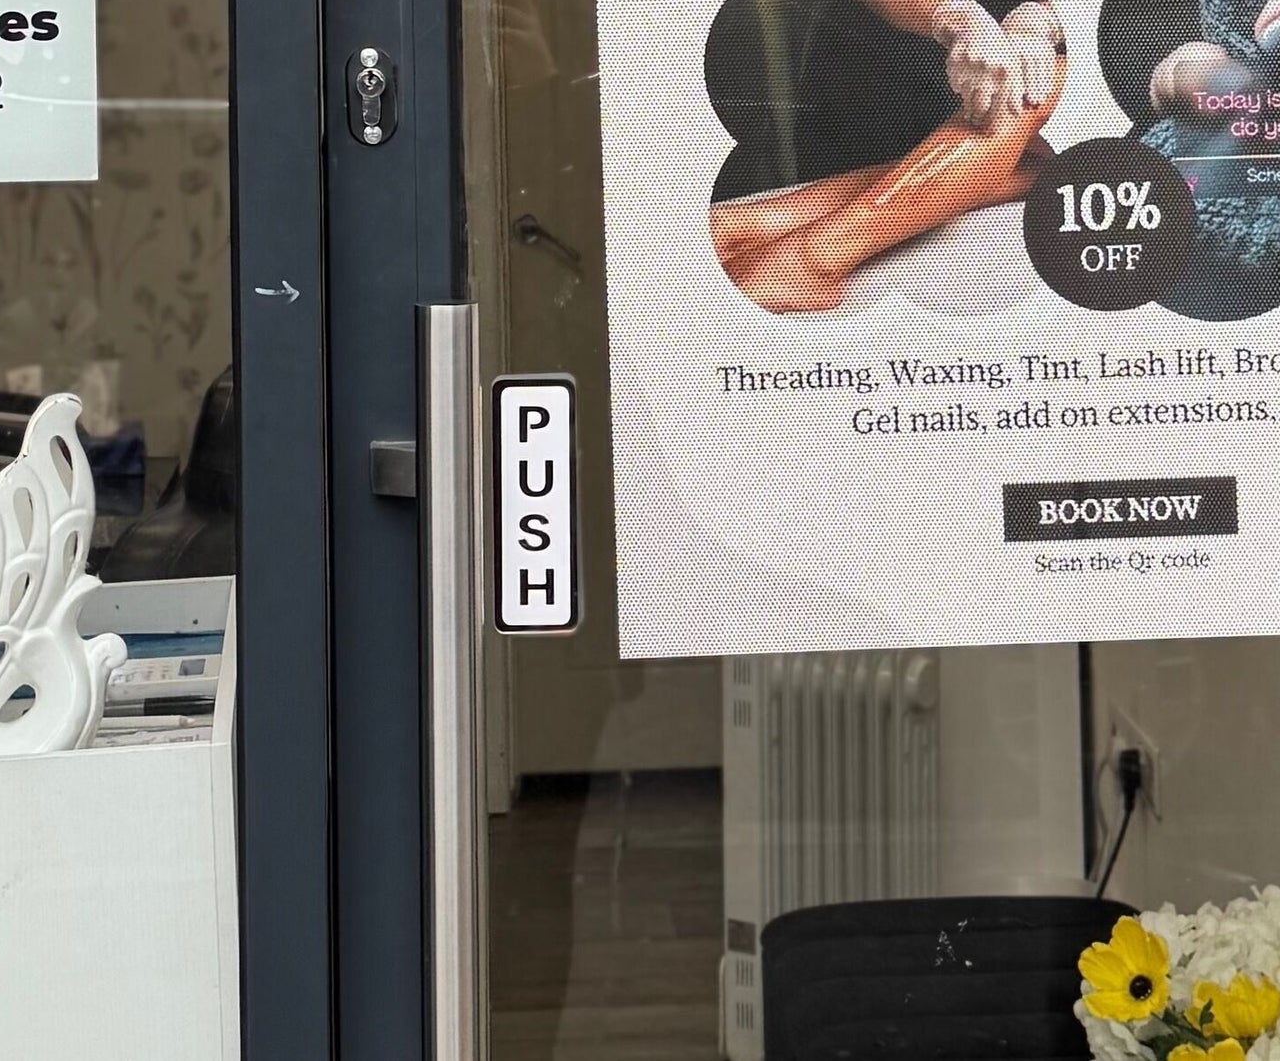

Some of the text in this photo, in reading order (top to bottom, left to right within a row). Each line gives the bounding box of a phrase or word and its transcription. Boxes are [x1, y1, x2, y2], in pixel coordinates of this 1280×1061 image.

[1193, 89, 1262, 113] Today
[1230, 117, 1259, 137] do
[1056, 181, 1162, 233] 10%
[1080, 243, 1143, 273] OFF
[716, 361, 881, 395] Threading,
[888, 357, 1013, 390] Waxing,
[1020, 353, 1090, 385] Tint,
[1098, 350, 1167, 379] Lash
[1176, 347, 1227, 380] lift,
[852, 406, 900, 435] Gel
[908, 402, 989, 436] nails,
[995, 400, 1051, 430] add
[1060, 406, 1098, 427] on
[1107, 395, 1278, 427] extensions,
[518, 405, 555, 606] PUSH
[1037, 495, 1202, 525] BOOK NOW
[1034, 548, 1211, 573] Scan the Qr code
